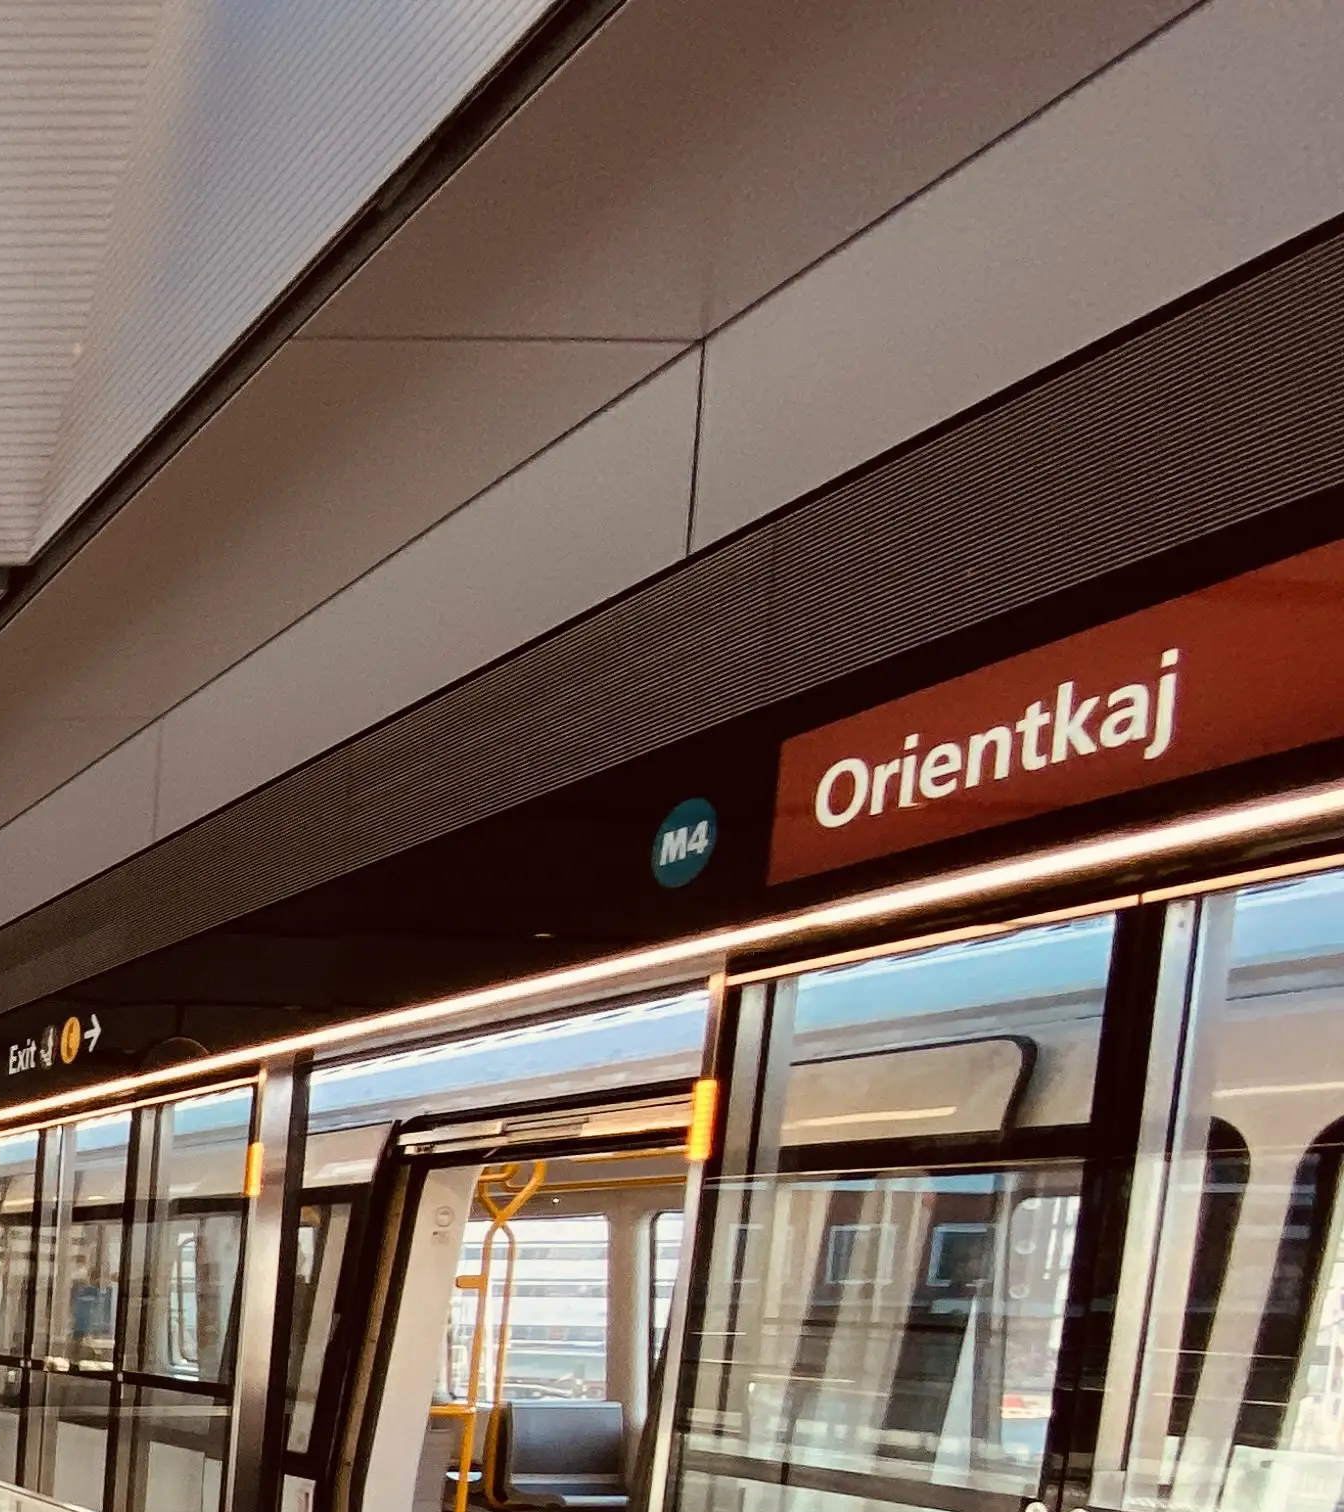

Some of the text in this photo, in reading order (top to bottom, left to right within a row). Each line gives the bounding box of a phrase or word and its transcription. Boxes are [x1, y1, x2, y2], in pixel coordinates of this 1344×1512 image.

[814, 647, 1180, 829] Orientkaj
[659, 820, 709, 866] M4
[8, 1038, 38, 1075] Exit
